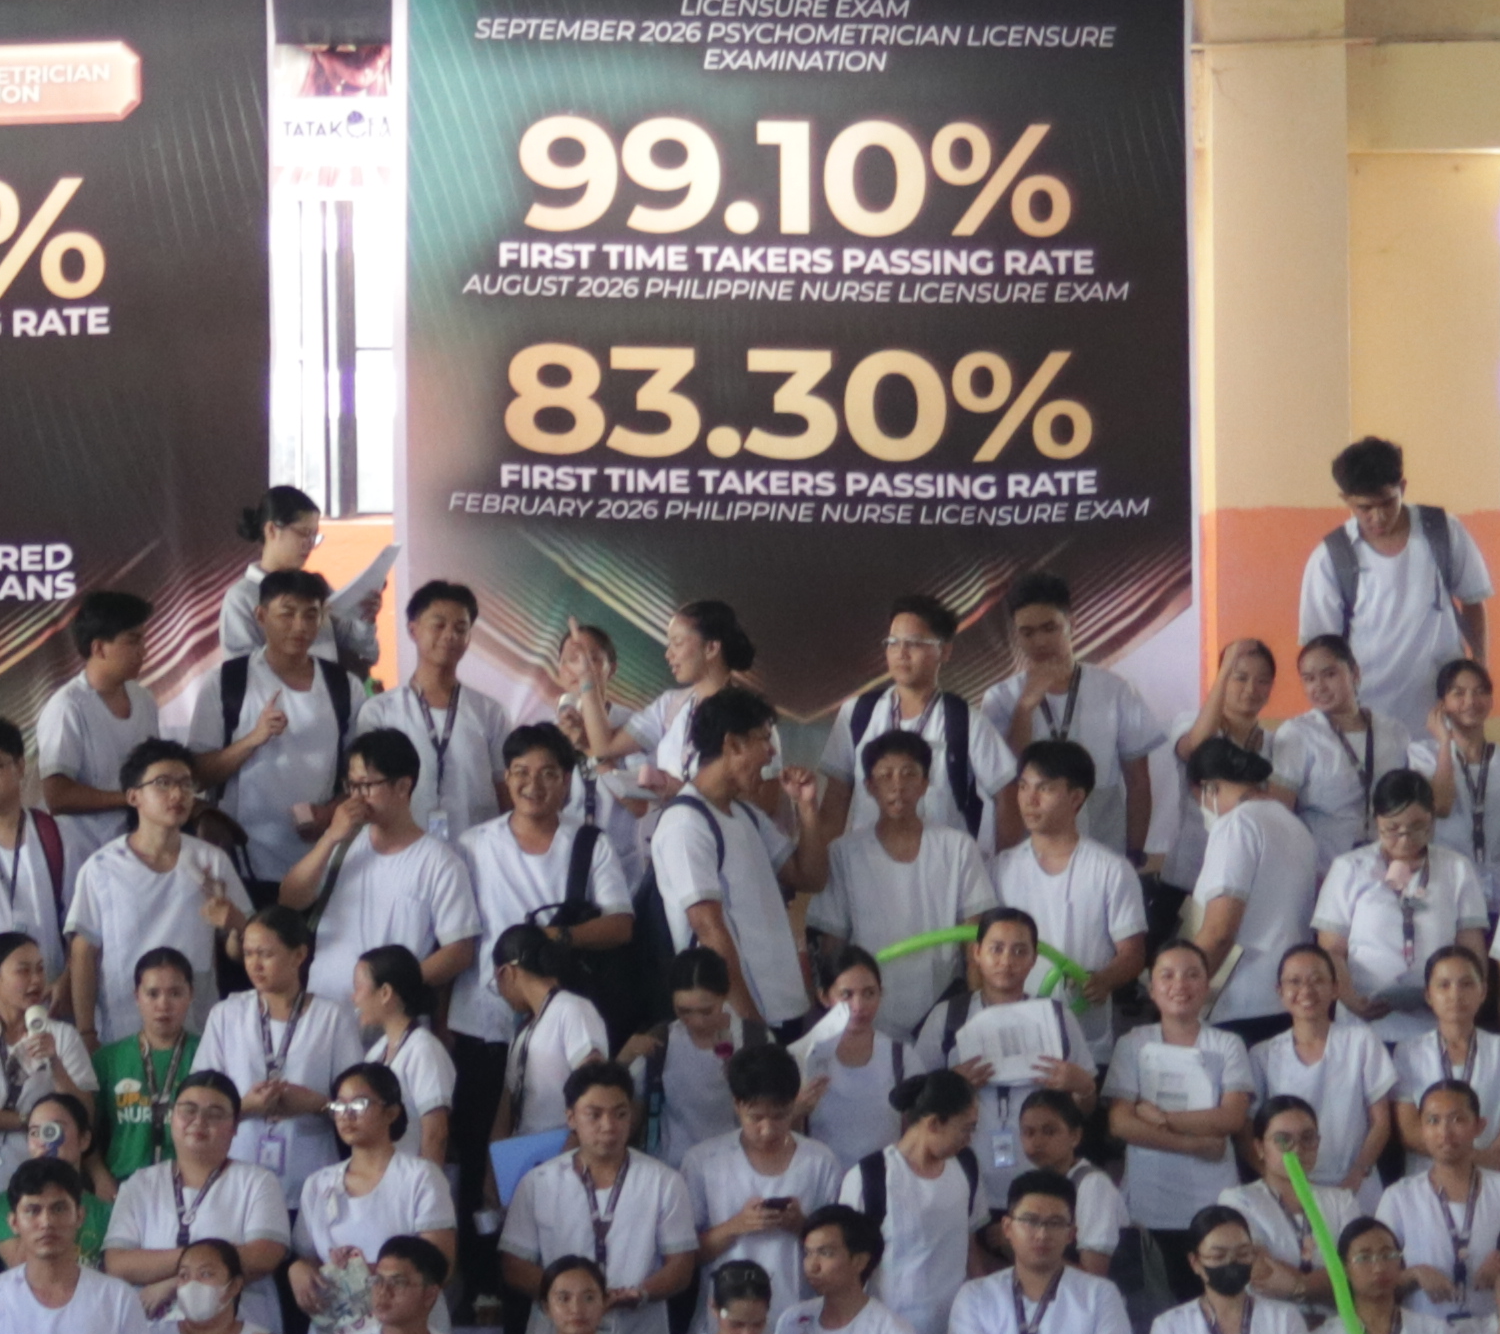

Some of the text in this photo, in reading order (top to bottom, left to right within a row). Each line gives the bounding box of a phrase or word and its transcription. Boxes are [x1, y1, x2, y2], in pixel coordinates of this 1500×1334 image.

[475, 19, 1115, 47] SEPTEMBER 2026 PSYCHOMETRICIAN LICENSURE
[703, 49, 887, 71] EXAMINATION
[519, 115, 1071, 237] 99.10%
[499, 243, 1094, 275] FIRST TIME TAKERS PASSING RATE
[463, 275, 1128, 302] AUGUST 2026 PHILIPPINE NURSE LICENSURE EXAM
[11, 308, 109, 337] RATE
[504, 343, 1092, 462] 83.30%
[500, 464, 1097, 496] FIRST TIME TAKERS PASSING RATE
[449, 492, 1149, 522] FEBRUARY 2026 PHILIPPINE NURSE LICENSURE EXAM
